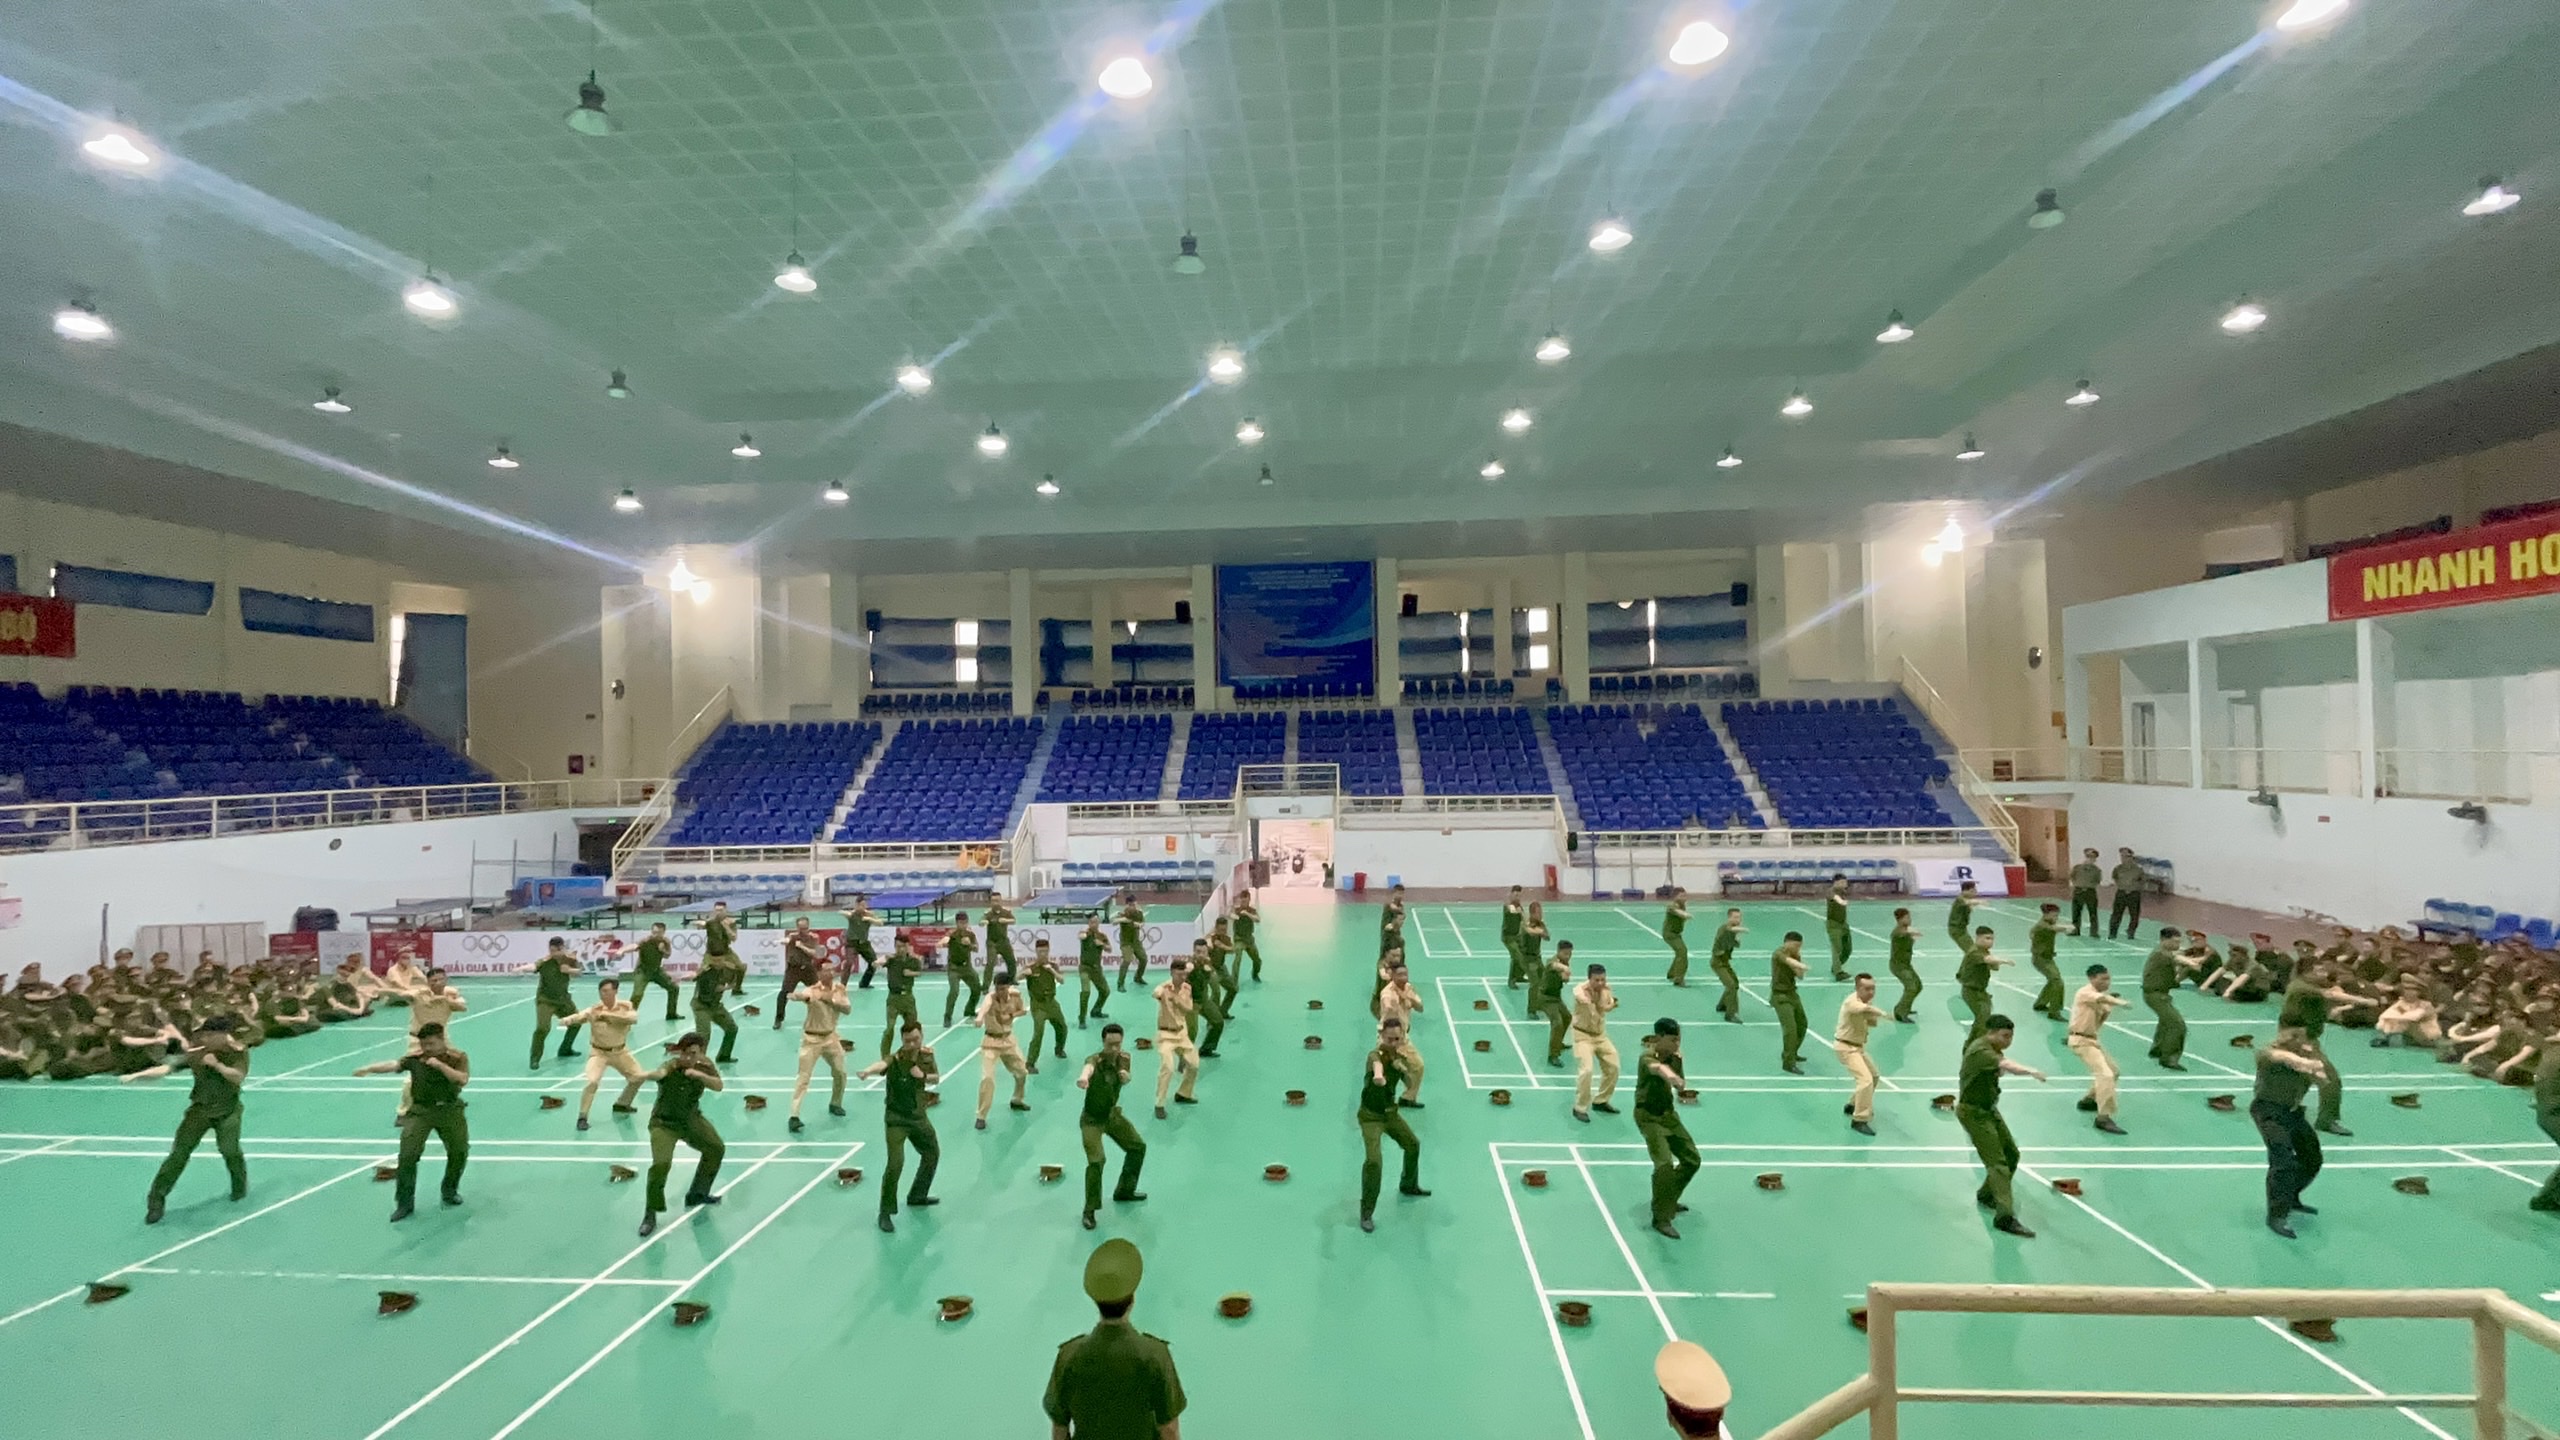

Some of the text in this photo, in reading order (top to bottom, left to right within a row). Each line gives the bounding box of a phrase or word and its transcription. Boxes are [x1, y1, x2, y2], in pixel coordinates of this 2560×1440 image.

[2363, 546, 2496, 602] NHANH
[1150, 955, 1169, 965] DAY
[491, 963, 505, 973] XE
